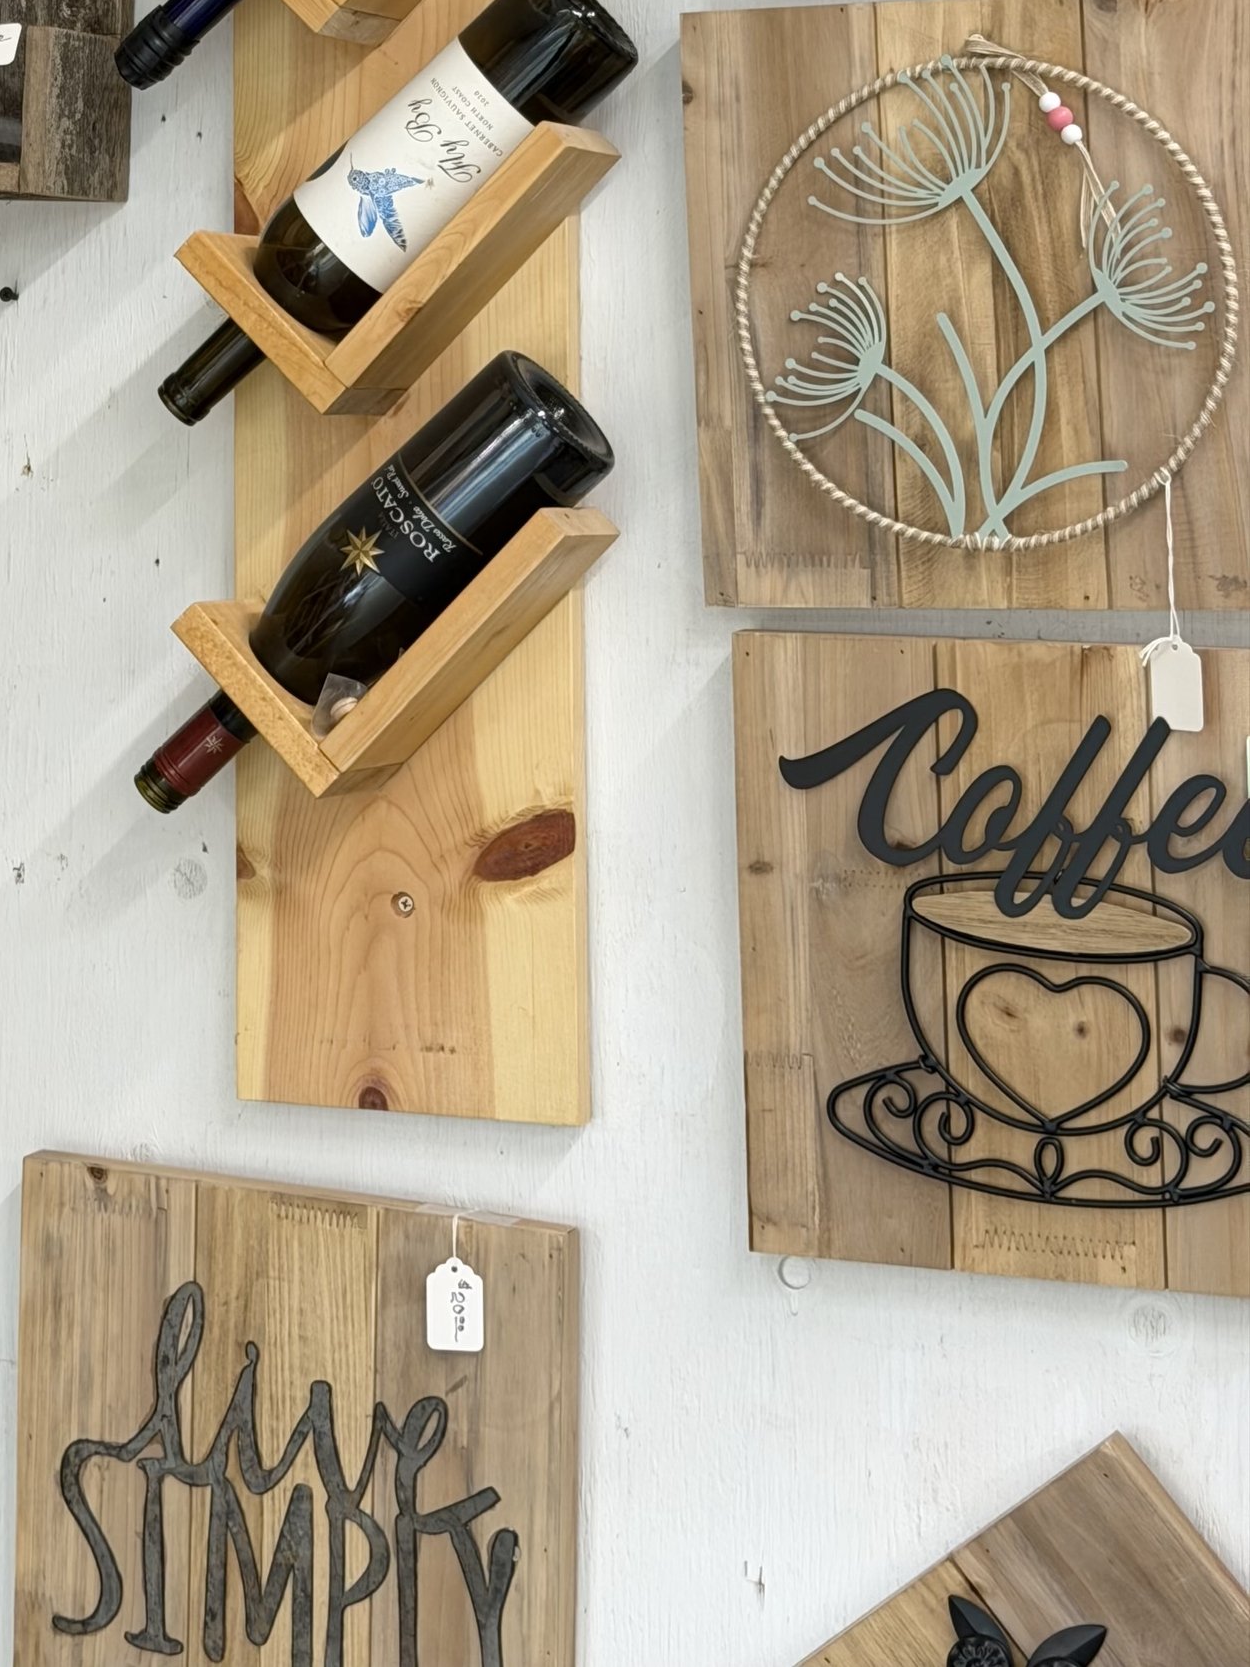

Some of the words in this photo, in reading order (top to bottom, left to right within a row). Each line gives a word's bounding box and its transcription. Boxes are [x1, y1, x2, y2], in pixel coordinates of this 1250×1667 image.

[430, 77, 466, 121] SAUVIGNON
[452, 86, 471, 107] COAST
[404, 98, 442, 142] By
[464, 120, 503, 157] CABERNET
[471, 107, 493, 131] NORTH
[437, 140, 481, 183] Fly
[372, 477, 440, 563] ROSCATO
